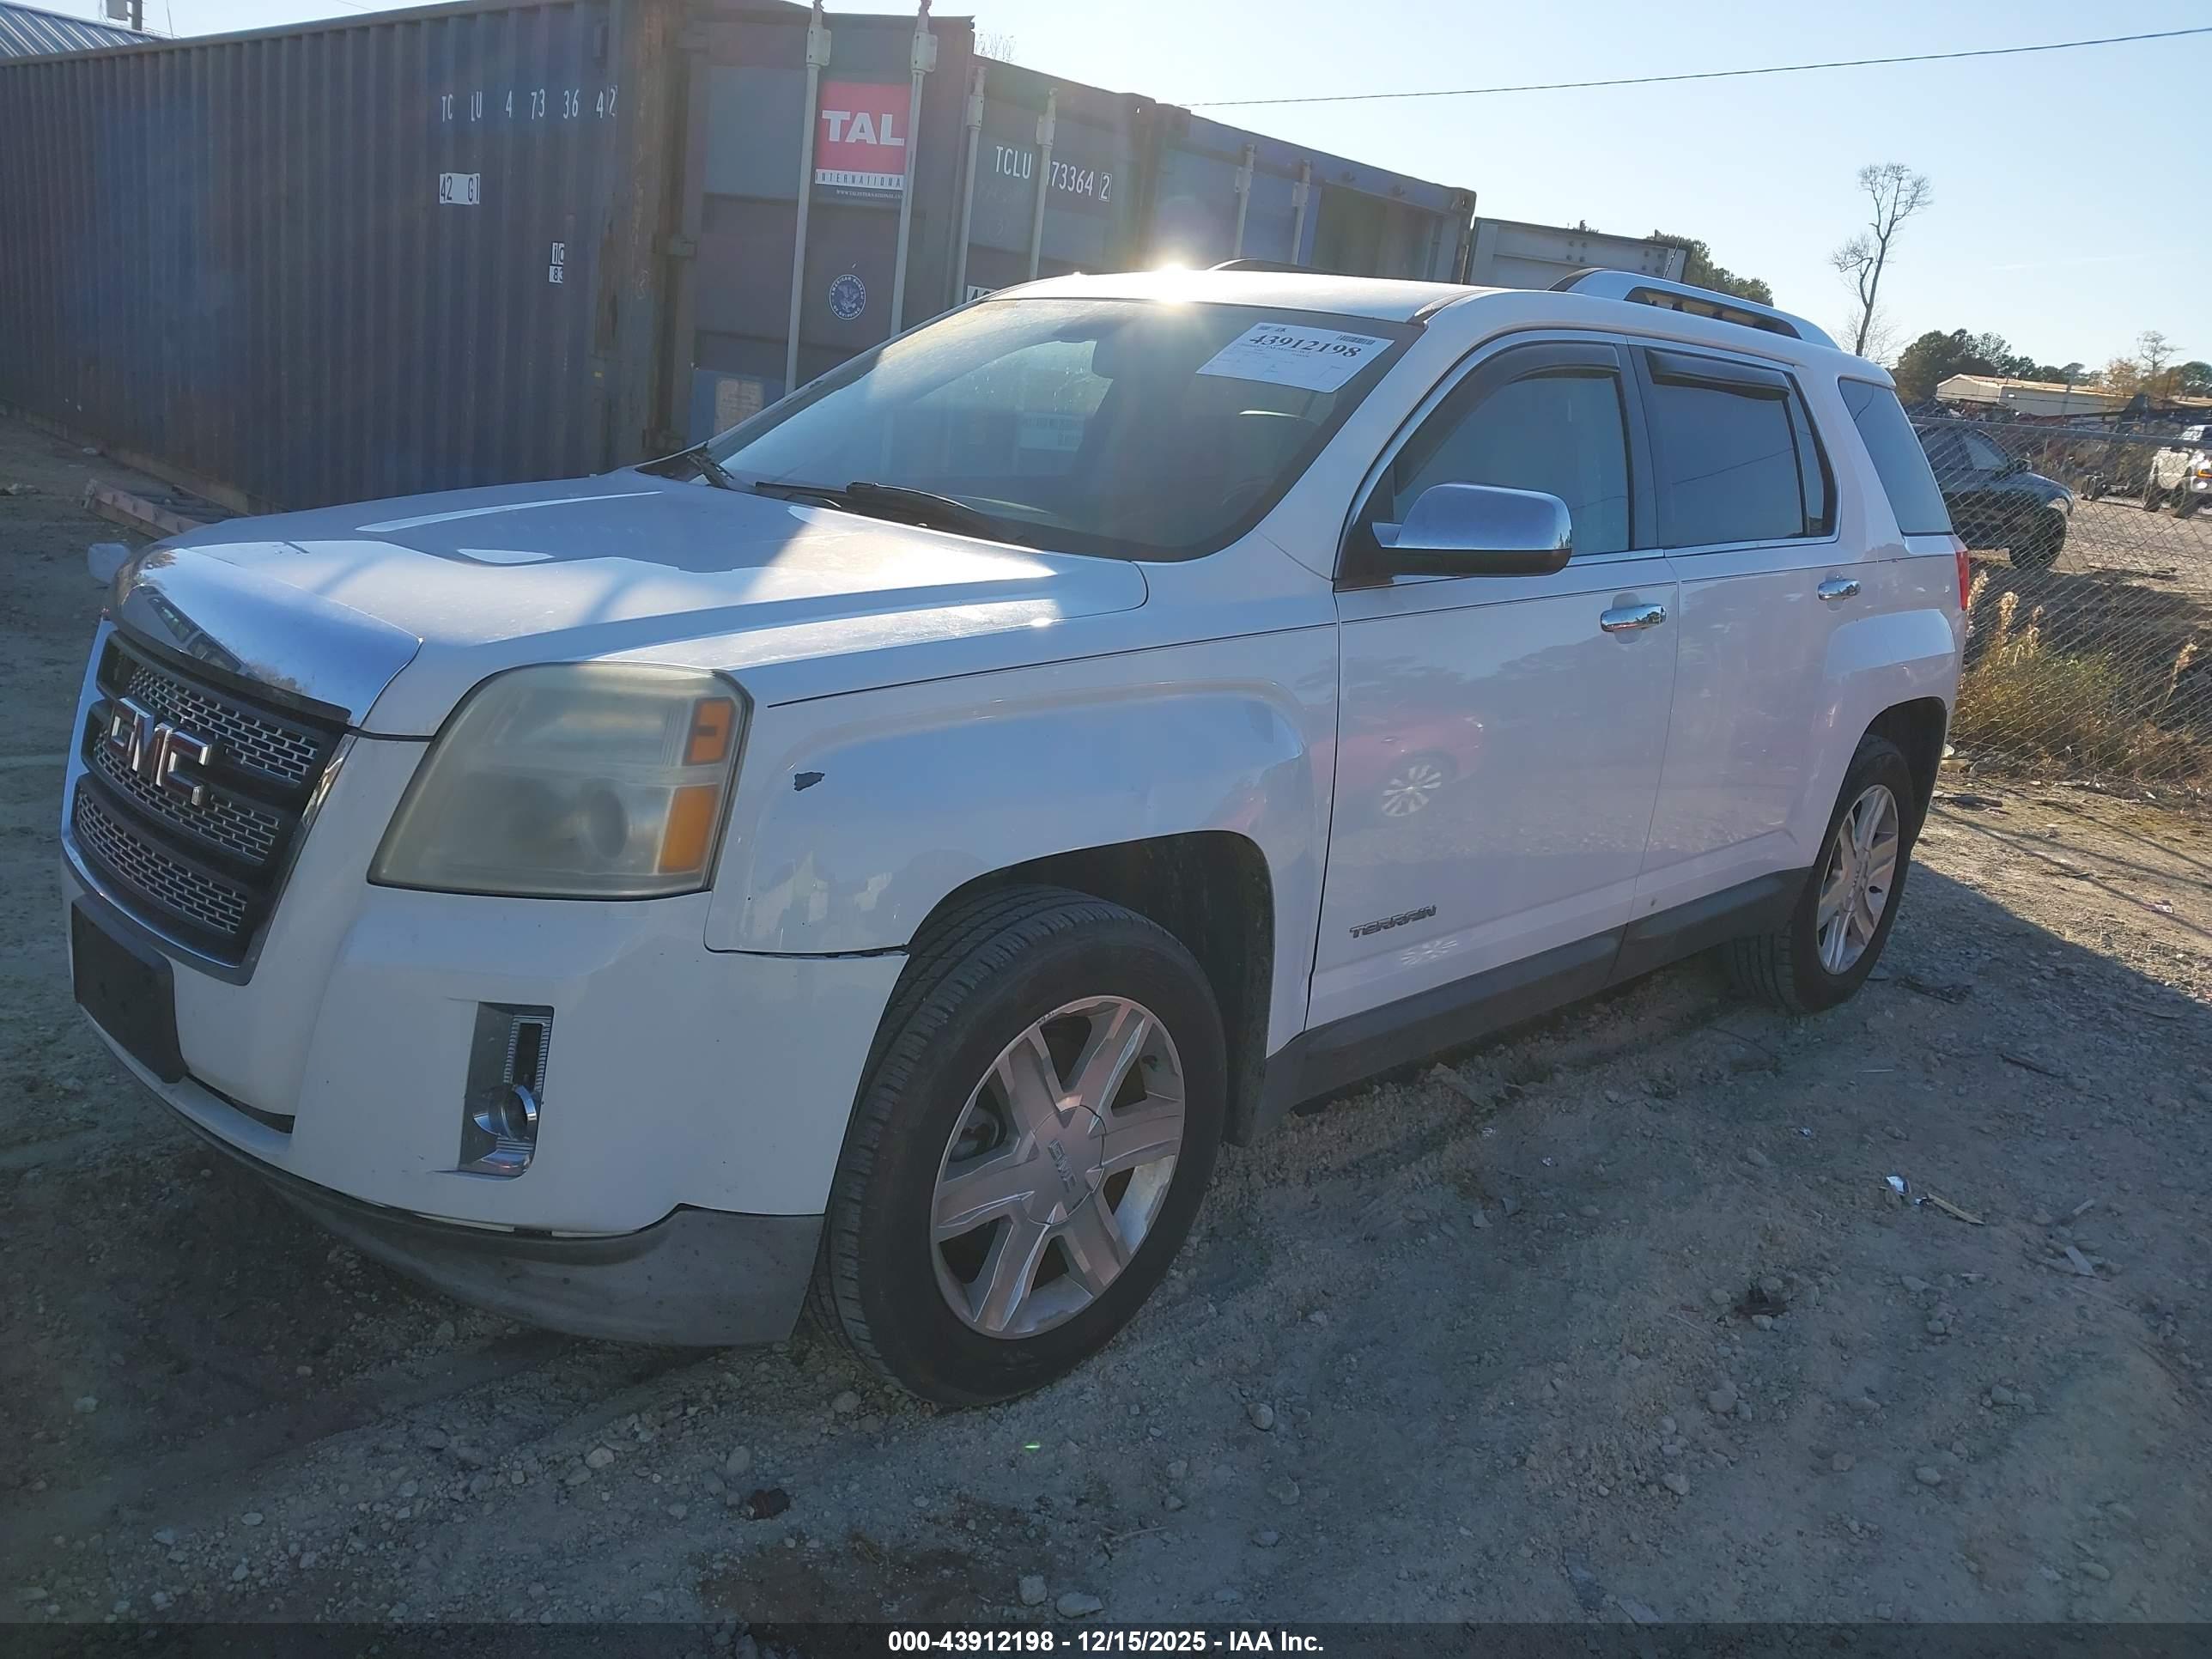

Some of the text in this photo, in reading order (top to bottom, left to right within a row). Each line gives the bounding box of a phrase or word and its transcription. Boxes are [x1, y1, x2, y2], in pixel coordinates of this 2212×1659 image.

[505, 90, 513, 118] 4
[531, 88, 545, 120] 73
[563, 89, 580, 118] 36
[822, 109, 905, 146] TAL
[440, 174, 453, 202] 42
[815, 171, 902, 188] INTERNATIONA
[995, 145, 1112, 201] TCLU 73364 2
[1249, 334, 1363, 358] 43912198
[110, 697, 212, 806] GMC
[1349, 904, 1437, 939] TERRAIN
[1048, 1139, 1078, 1194] GMC
